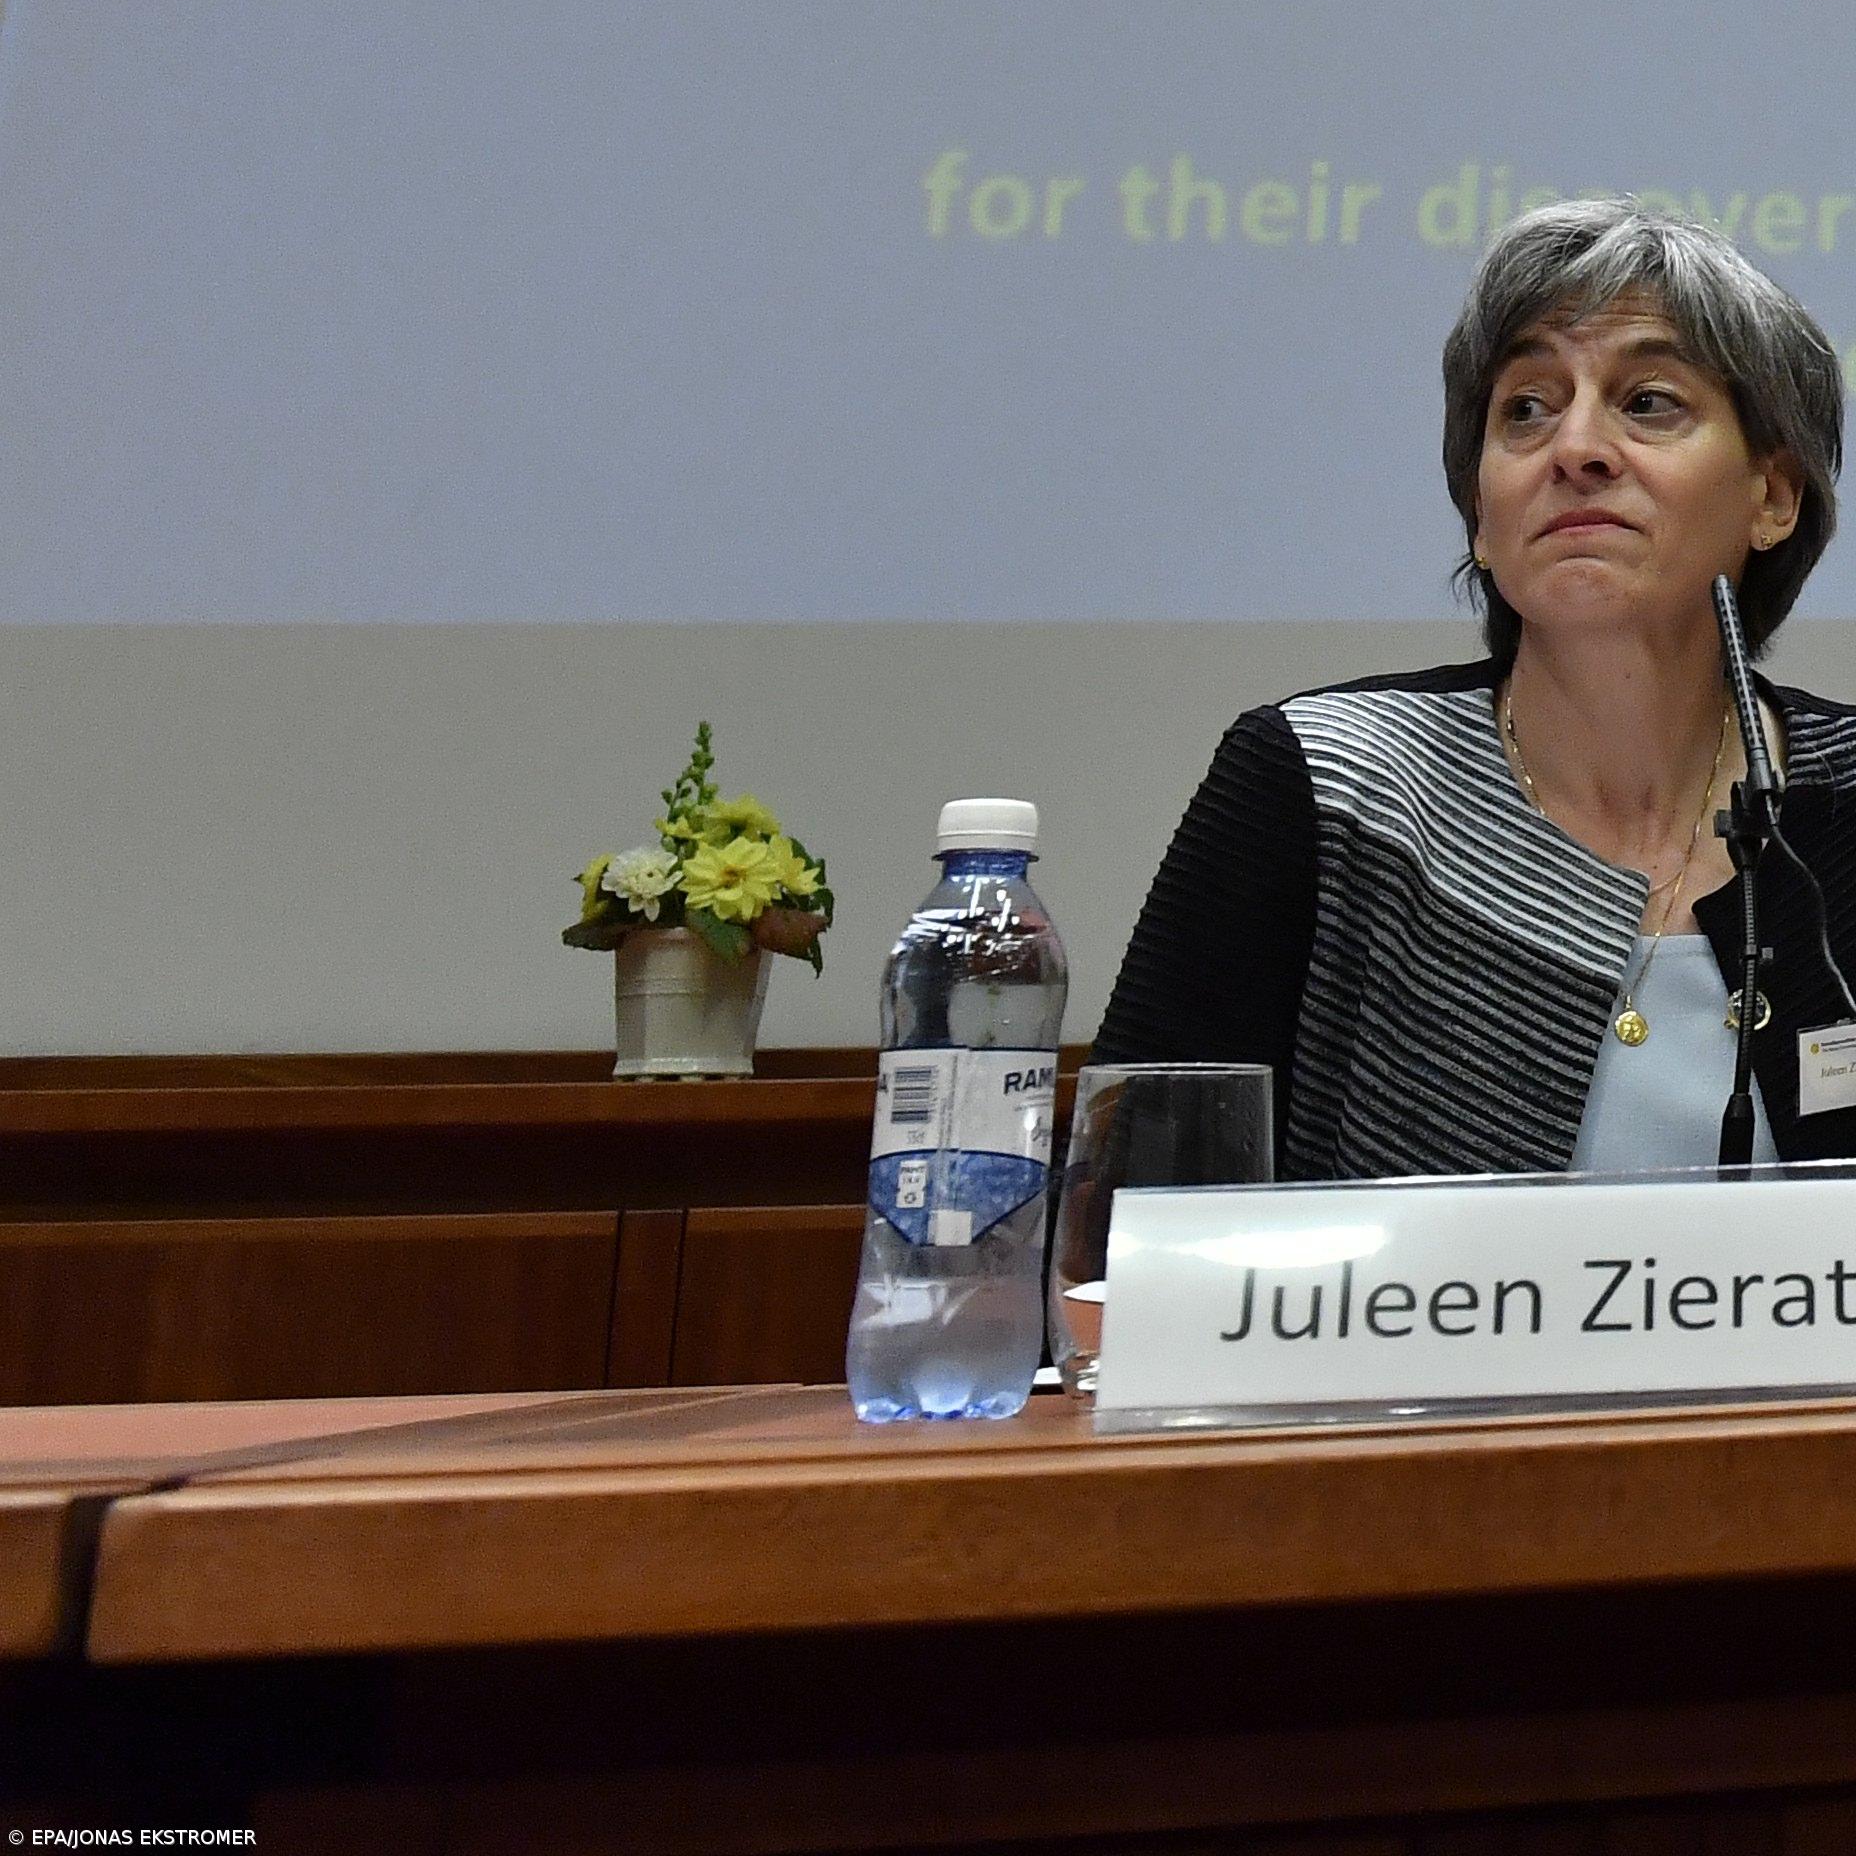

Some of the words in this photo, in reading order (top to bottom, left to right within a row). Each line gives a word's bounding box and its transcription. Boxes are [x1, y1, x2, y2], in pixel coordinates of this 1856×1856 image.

[925, 149, 1084, 242] for
[1121, 154, 1382, 246] their
[1218, 1258, 1544, 1343] Juleen
